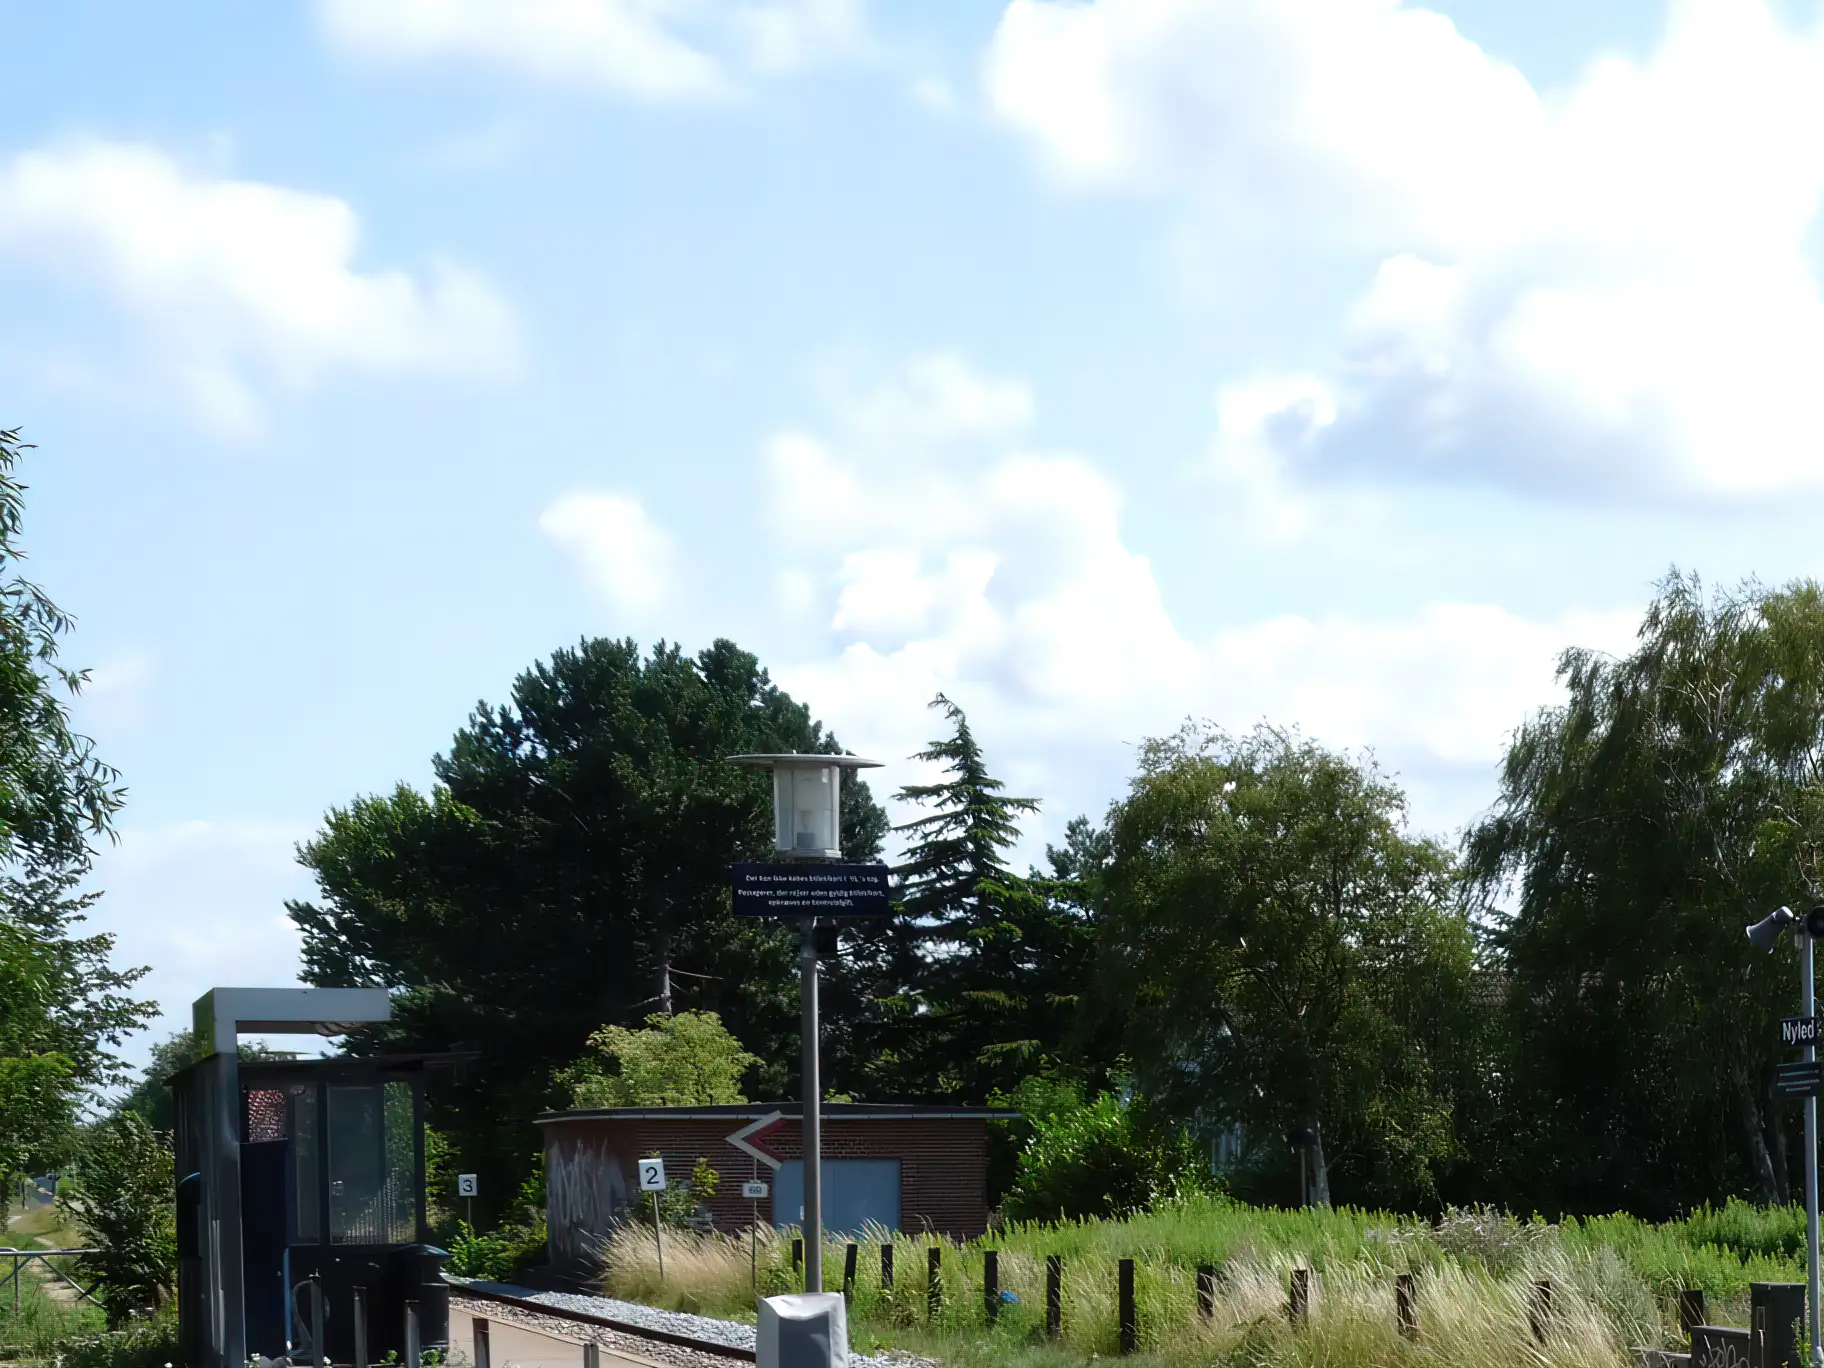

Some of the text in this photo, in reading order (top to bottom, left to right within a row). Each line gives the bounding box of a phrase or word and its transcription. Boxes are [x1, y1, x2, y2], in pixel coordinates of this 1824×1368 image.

[1782, 1020, 1815, 1045] Nyled
[645, 1166, 660, 1185] 2
[463, 1179, 473, 1192] 3
